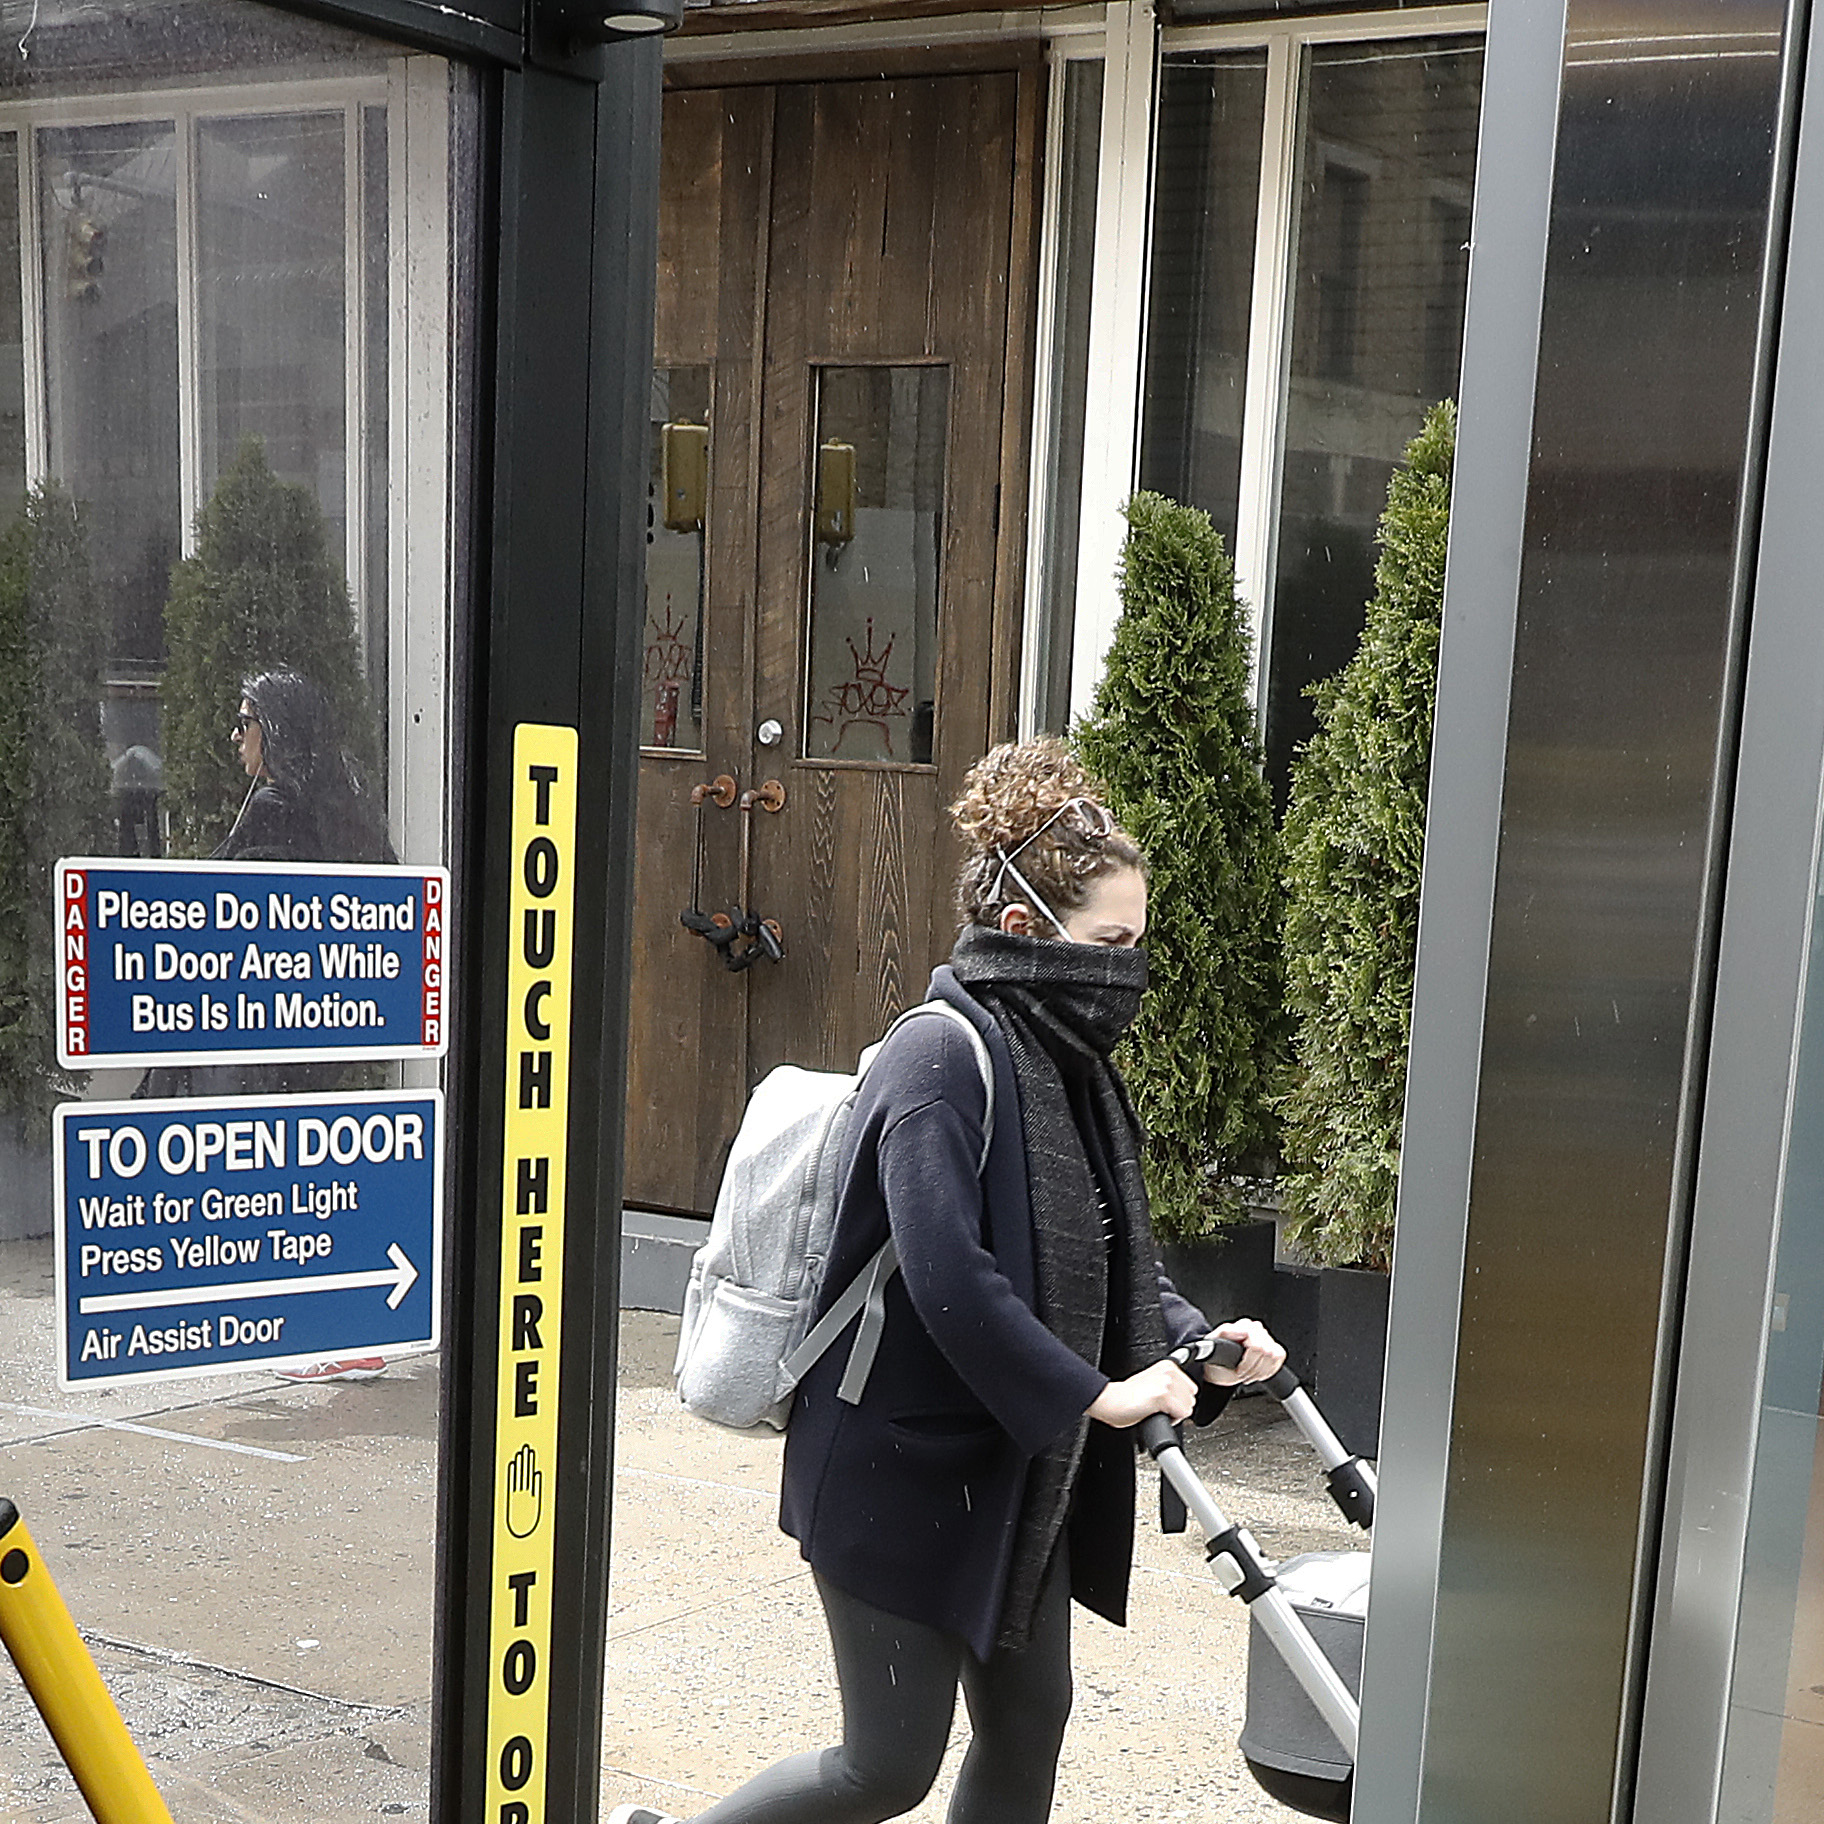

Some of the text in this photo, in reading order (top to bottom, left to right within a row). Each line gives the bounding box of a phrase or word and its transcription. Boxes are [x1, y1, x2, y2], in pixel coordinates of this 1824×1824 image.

[97, 889, 415, 932] Please Do Not Stand
[518, 765, 558, 1109] TOUCH
[65, 872, 87, 1054] DANGER
[114, 942, 401, 981] In Door Area While
[423, 878, 442, 1046] DANGER
[131, 991, 386, 1033] Bus Is In Motion.
[78, 1113, 424, 1180] TO OPEN DOOR
[79, 1180, 360, 1230] Wait for Green Light
[80, 1228, 333, 1278] Press Yellow Tape
[511, 1158, 549, 1418] HERE
[80, 1314, 285, 1363] Air Assist Door
[501, 1573, 537, 1695] TO
